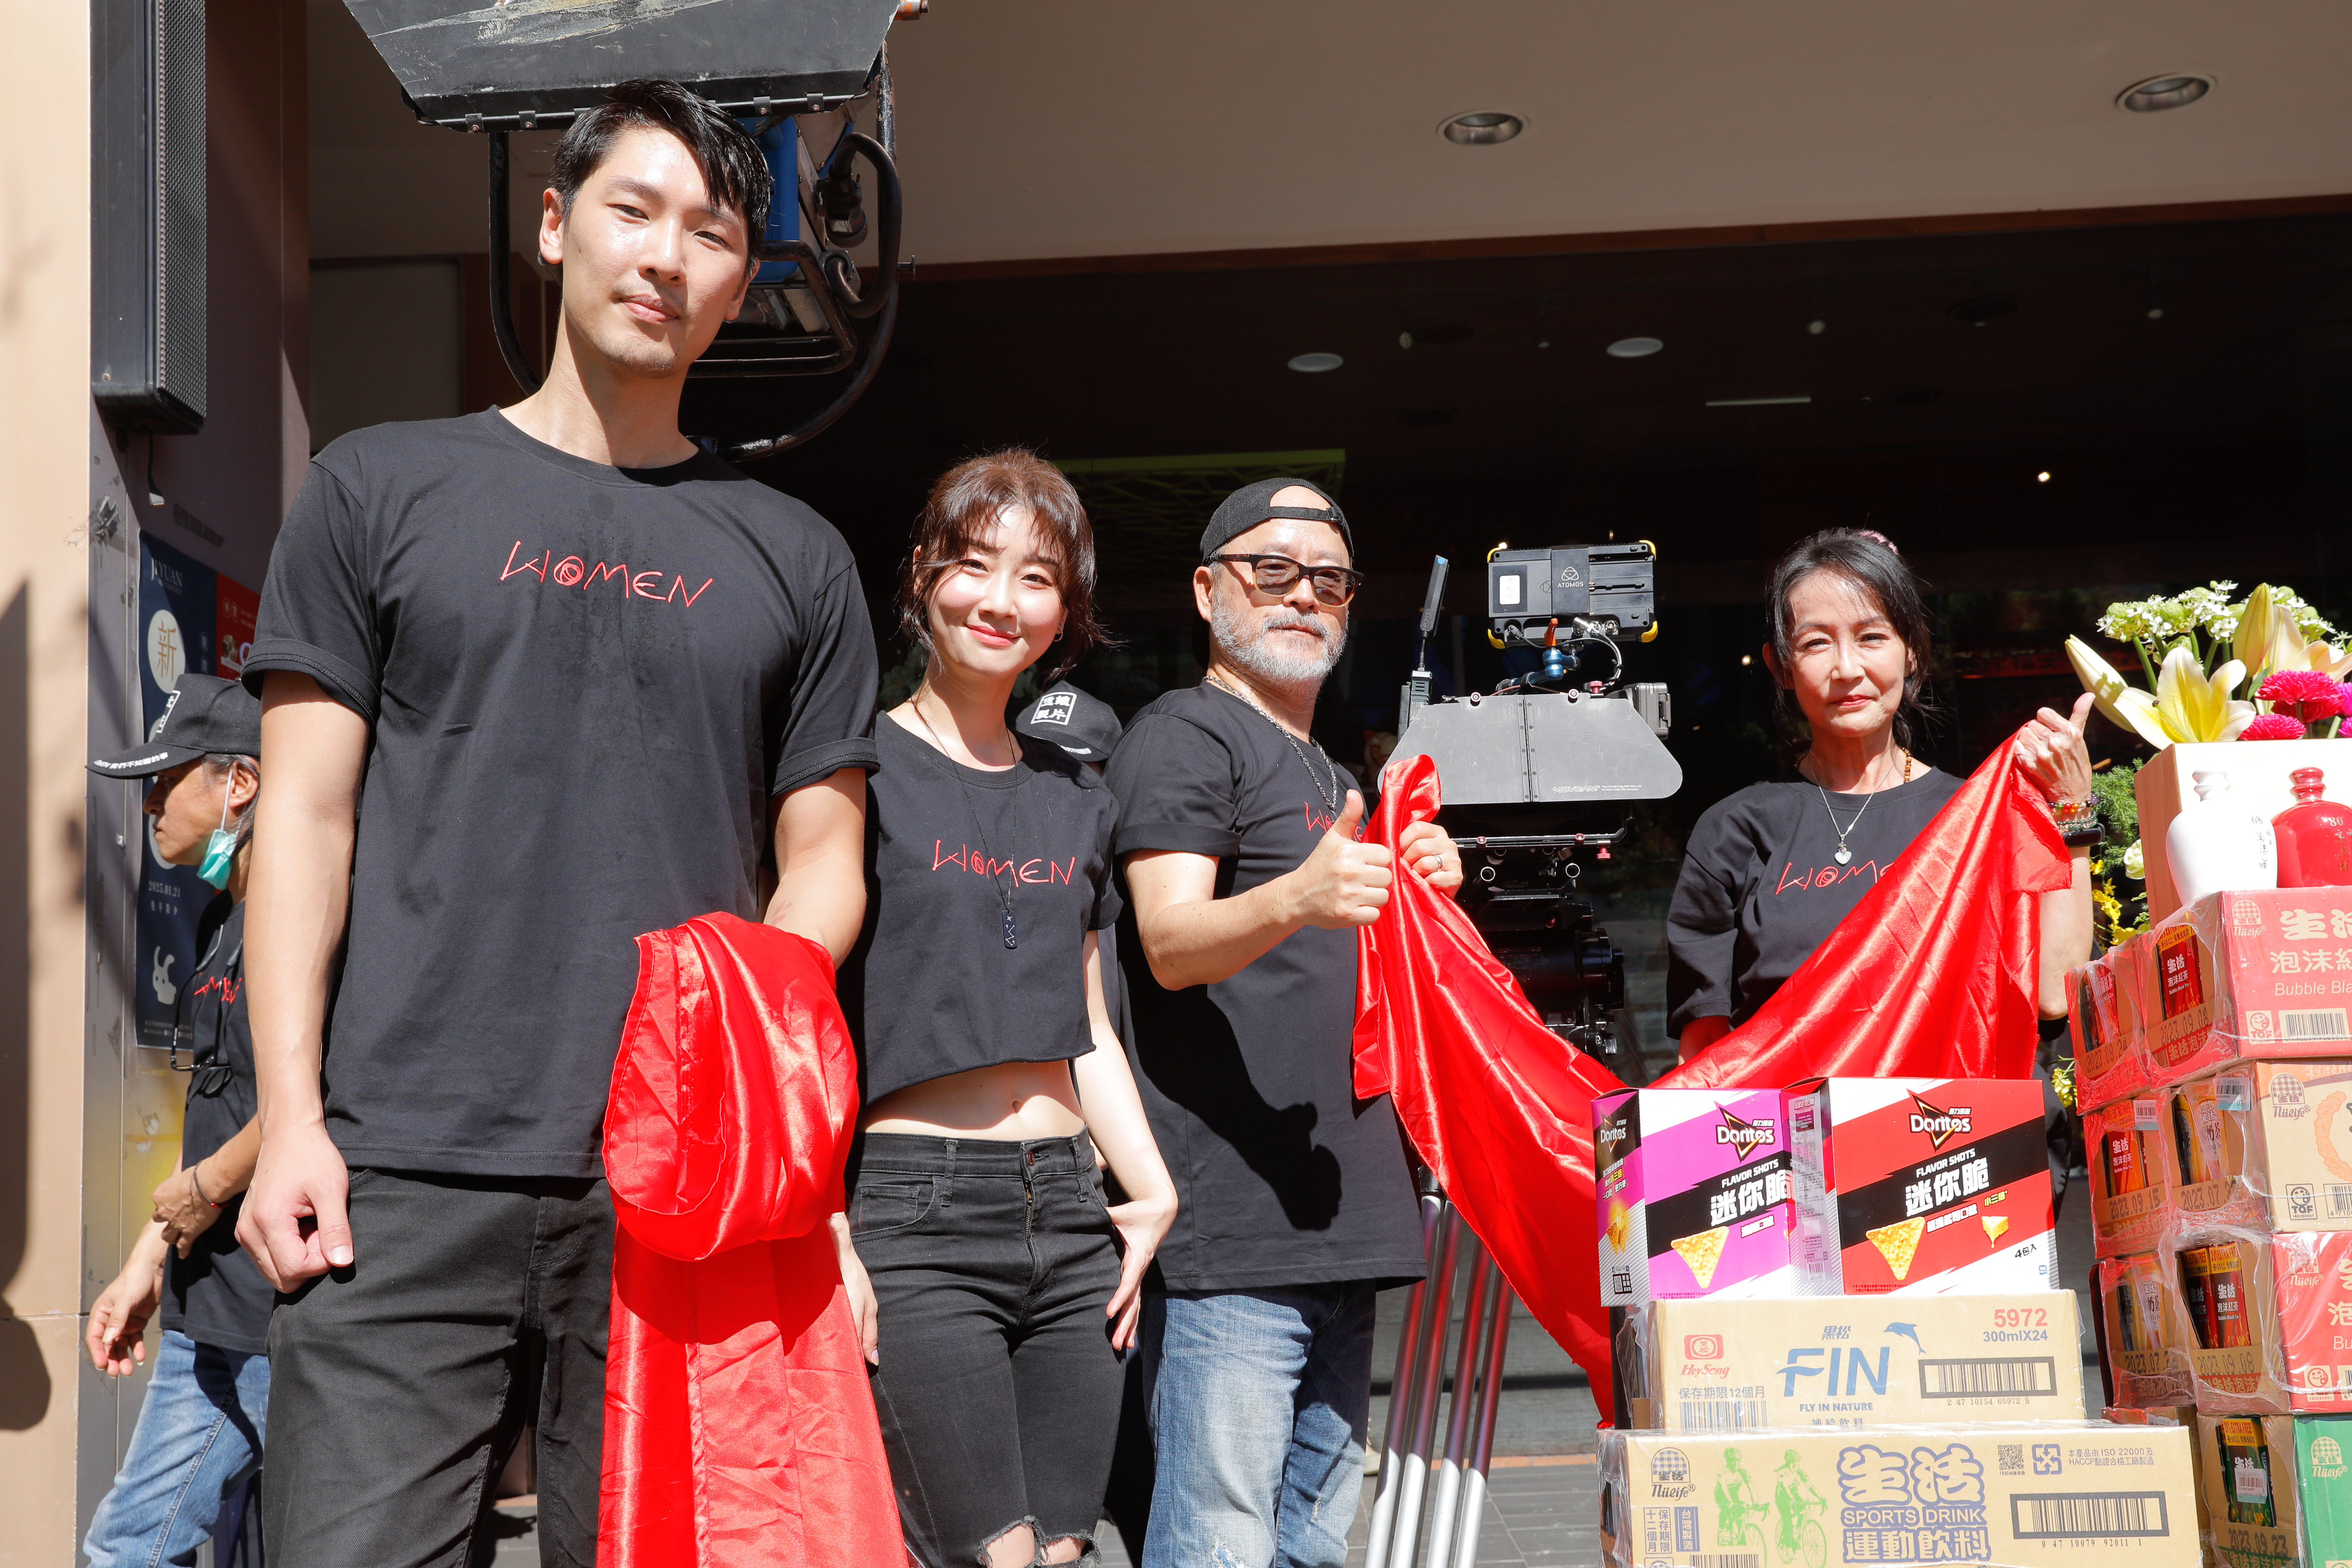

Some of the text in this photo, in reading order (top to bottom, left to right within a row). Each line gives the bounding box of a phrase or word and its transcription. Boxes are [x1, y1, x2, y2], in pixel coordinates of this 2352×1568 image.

[500, 541, 713, 607] WOMEN
[932, 839, 1076, 888] WOMEN
[2167, 954, 2185, 974] 生活
[2167, 970, 2188, 987] 泡沫紅茶
[2275, 981, 2325, 996] Bubble
[2278, 1094, 2299, 1103] 生活
[1949, 1107, 1971, 1115] 多力多滋
[1910, 1114, 1972, 1133] Doritos
[1601, 1127, 1626, 1143] Doritos
[1717, 1125, 1774, 1144] Doritos
[2113, 1137, 2129, 1154] 生活
[1916, 1148, 1976, 1178] FLAVOR SHOTS
[2113, 1153, 2132, 1166] 泡沫奶茶
[1722, 1159, 1779, 1188] FLAVOR SHOTS
[1905, 1156, 1990, 1217] 迷你脆
[1711, 1168, 1788, 1227] 迷你脆
[2291, 1205, 2313, 1214] TQF
[2014, 1243, 2037, 1259] 4包入
[2217, 1247, 2229, 1261] EXTRA
[2218, 1283, 2235, 1299] 生活
[2217, 1301, 2238, 1313] 泡沫紅茶
[1994, 1308, 2048, 1328] 5972
[1821, 1326, 1851, 1340] 黑松
[1983, 1329, 2048, 1342] 300mlX24
[1775, 1347, 1890, 1397] FIN
[1679, 1386, 1765, 1400] 保存期限12個月
[1800, 1402, 1873, 1412] FLY IN NATURE
[2231, 1422, 2242, 1433] EXTRA
[2242, 1422, 2252, 1434] FREE
[2068, 1448, 2099, 1457] 本產品由
[2118, 1448, 2144, 1456] 22000
[2147, 1447, 2153, 1456] 及
[2069, 1457, 2154, 1466] HACCP驗證合格工廠製造
[1658, 1470, 1684, 1481] 生活
[1836, 1443, 1985, 1506] 生活
[1844, 1508, 1983, 1525] SPORTS DRINK
[1645, 1509, 1657, 1553] 十二個月
[1658, 1509, 1670, 1552] 保存期限
[1681, 1509, 1694, 1551] 台灣製造
[1846, 1529, 1989, 1560] 運動飲料
[2070, 1539, 2095, 1547] 10079
[2104, 1538, 2129, 1546] 92011
